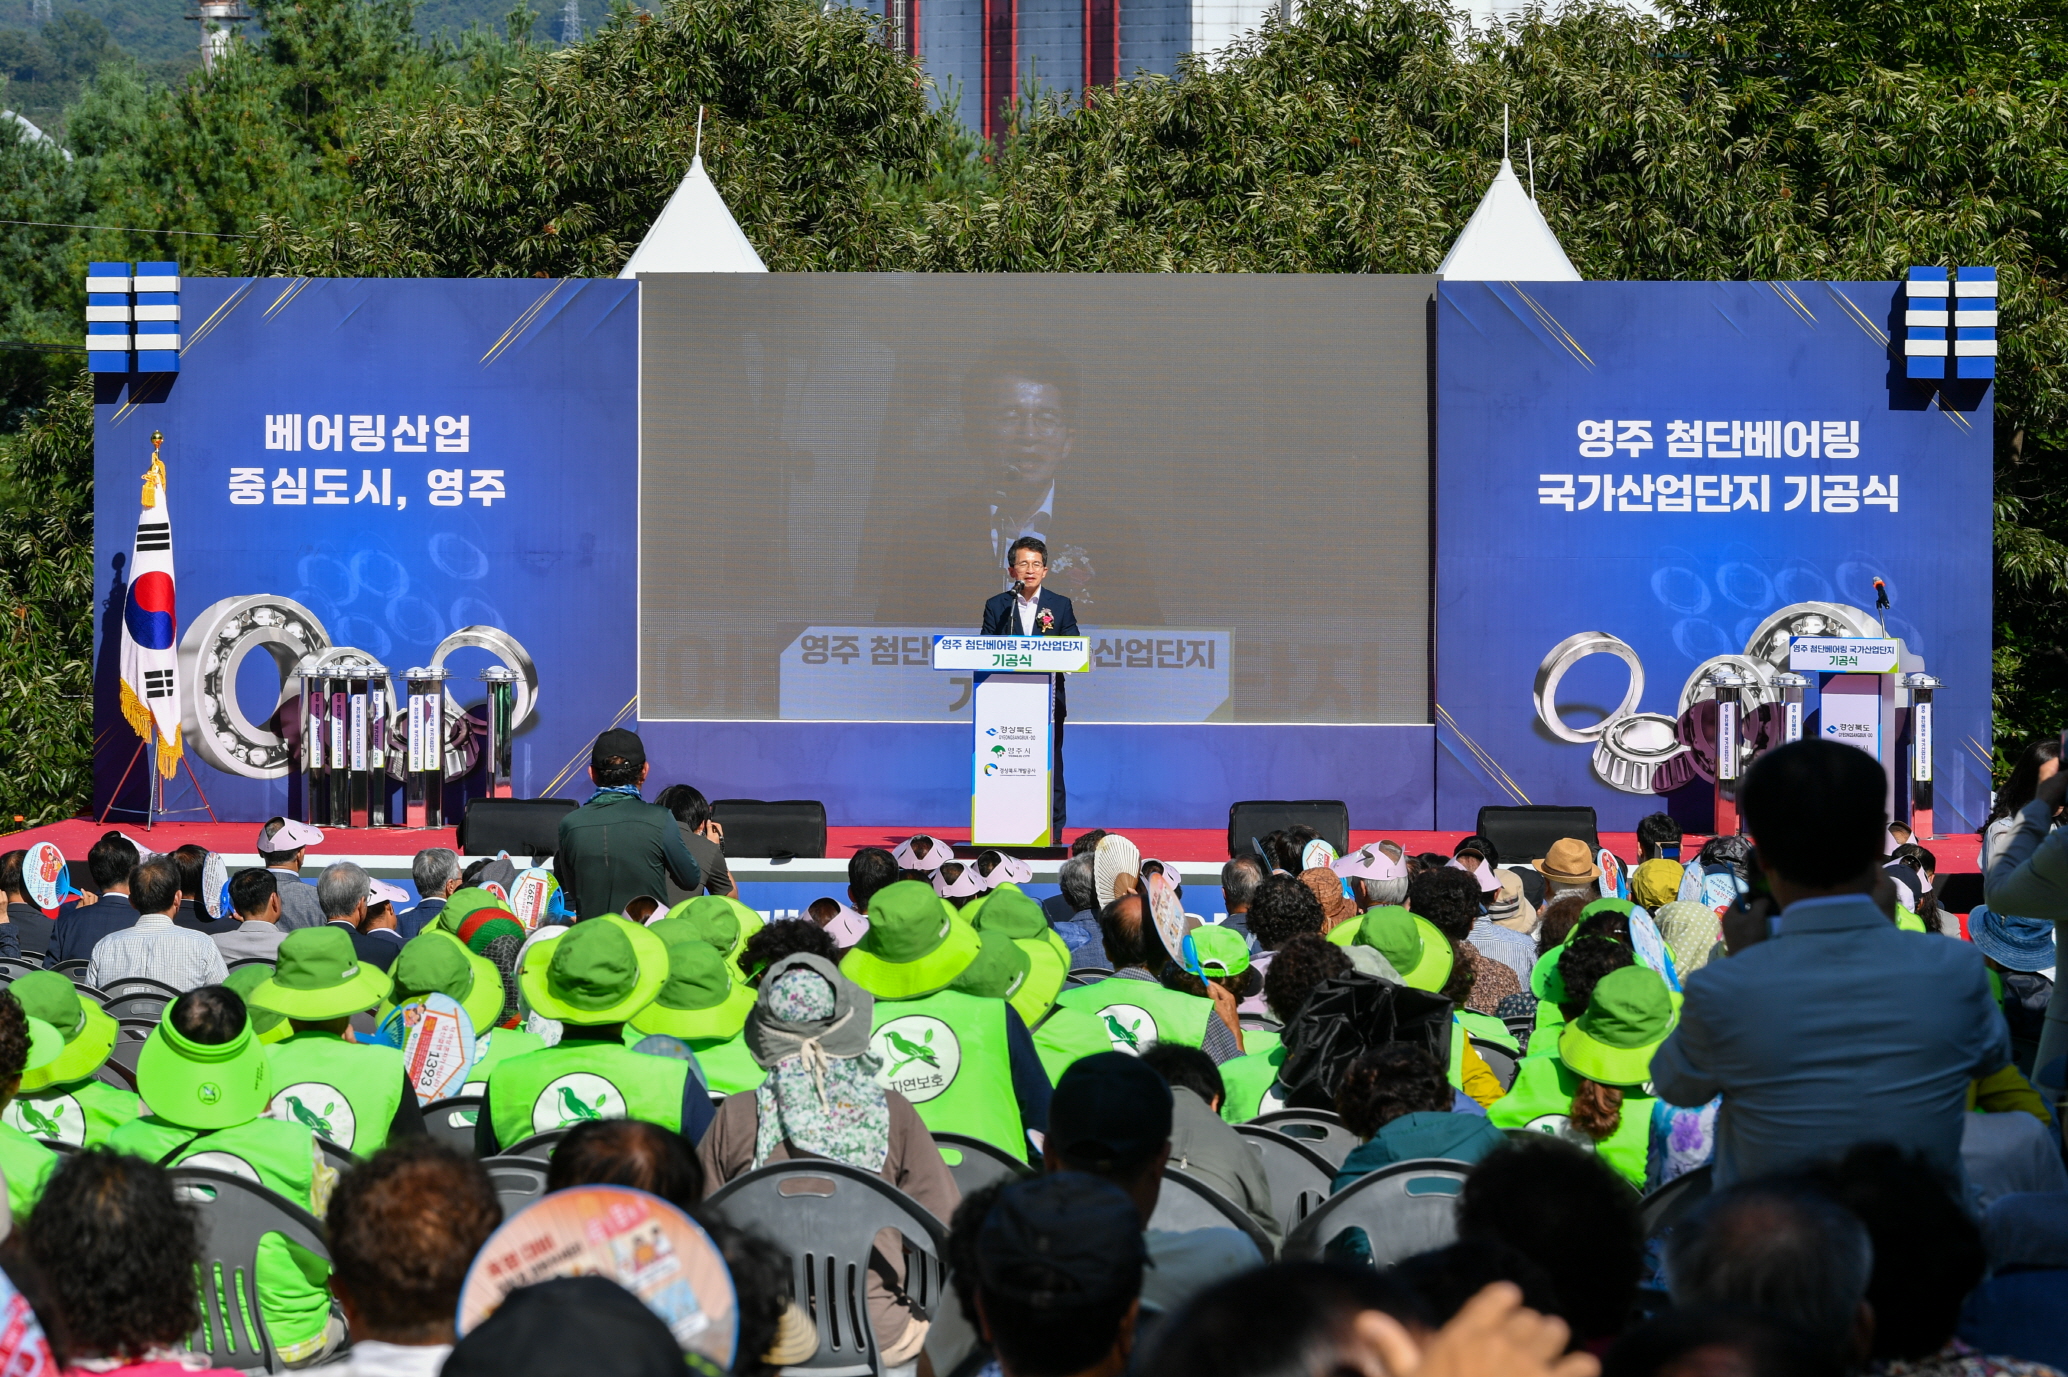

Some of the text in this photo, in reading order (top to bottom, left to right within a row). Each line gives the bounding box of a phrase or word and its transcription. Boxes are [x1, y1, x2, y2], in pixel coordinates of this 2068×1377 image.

[265, 413, 470, 453] 베어링산업
[1577, 419, 1860, 459] 영주 첨단베어링
[228, 467, 506, 511] 중심도시, 영주
[1537, 473, 1899, 513] 국가산업단지 기공식
[800, 634, 860, 665] 영주
[1094, 638, 1215, 669] 산업단지
[941, 639, 1083, 652] 영주 첨단베어링 국가산업단지
[1793, 644, 1895, 655] 영주 첨단베어링 국가산업단지
[992, 653, 1032, 668] 기공식
[1829, 655, 1858, 666] 기공식
[1839, 723, 1870, 732] 경상북도
[526, 883, 536, 906] 1393
[421, 1051, 440, 1087] 1393
[889, 1073, 944, 1094] 자연보호
